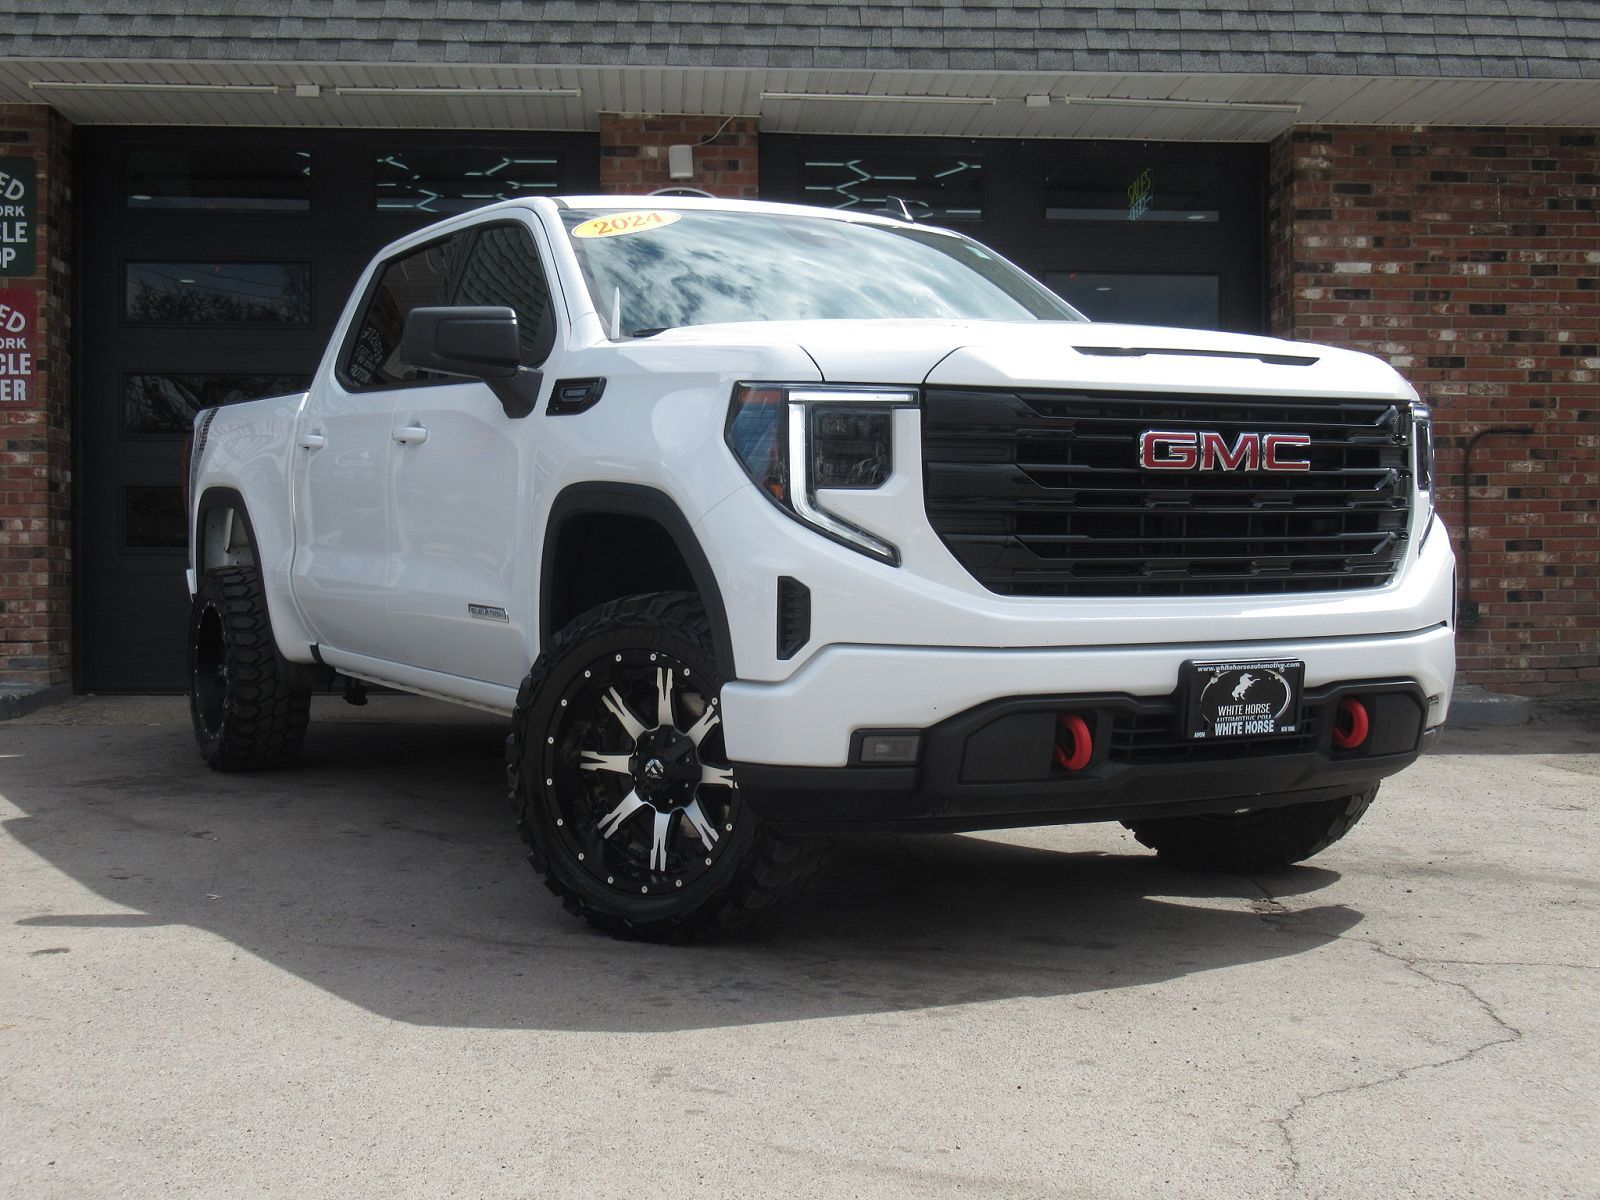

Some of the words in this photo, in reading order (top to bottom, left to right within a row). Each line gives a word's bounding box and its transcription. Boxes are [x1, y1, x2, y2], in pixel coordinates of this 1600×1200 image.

[0, 221, 28, 243] LE
[593, 212, 663, 235] 2024
[0, 379, 26, 401] ER
[1139, 431, 1311, 472] GMC
[1197, 662, 1300, 672] www.whitehorseautomotive.com
[1218, 705, 1243, 716] WHITE
[1245, 703, 1271, 714] HORSE
[1214, 721, 1243, 736] WHITE
[1245, 719, 1275, 734] HORSE
